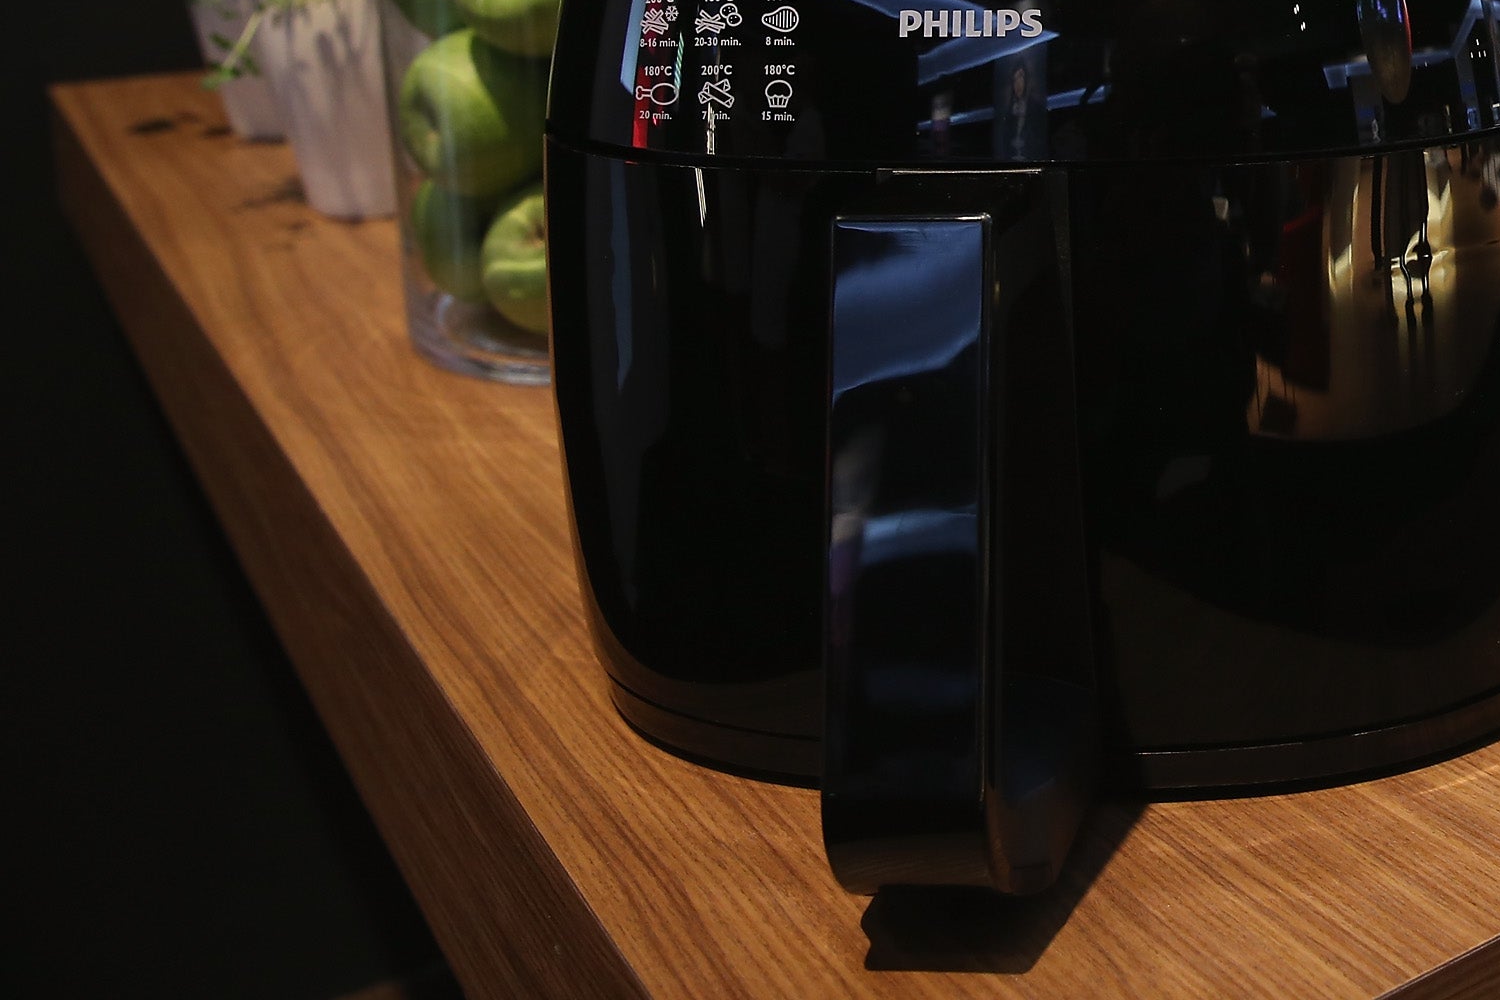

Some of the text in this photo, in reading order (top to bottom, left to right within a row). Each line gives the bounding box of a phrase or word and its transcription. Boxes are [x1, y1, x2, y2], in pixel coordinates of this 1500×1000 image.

[899, 9, 1043, 38] PHILIPS
[659, 37, 679, 47] min.
[694, 36, 742, 46] 20-30 min.
[765, 36, 796, 46] 8 min.
[644, 65, 673, 76] 180°C
[701, 64, 733, 75] 200°C
[764, 64, 796, 75] 180°C
[639, 111, 673, 120] 20 min.
[701, 110, 708, 120] 7
[761, 111, 796, 122] 15 min.
